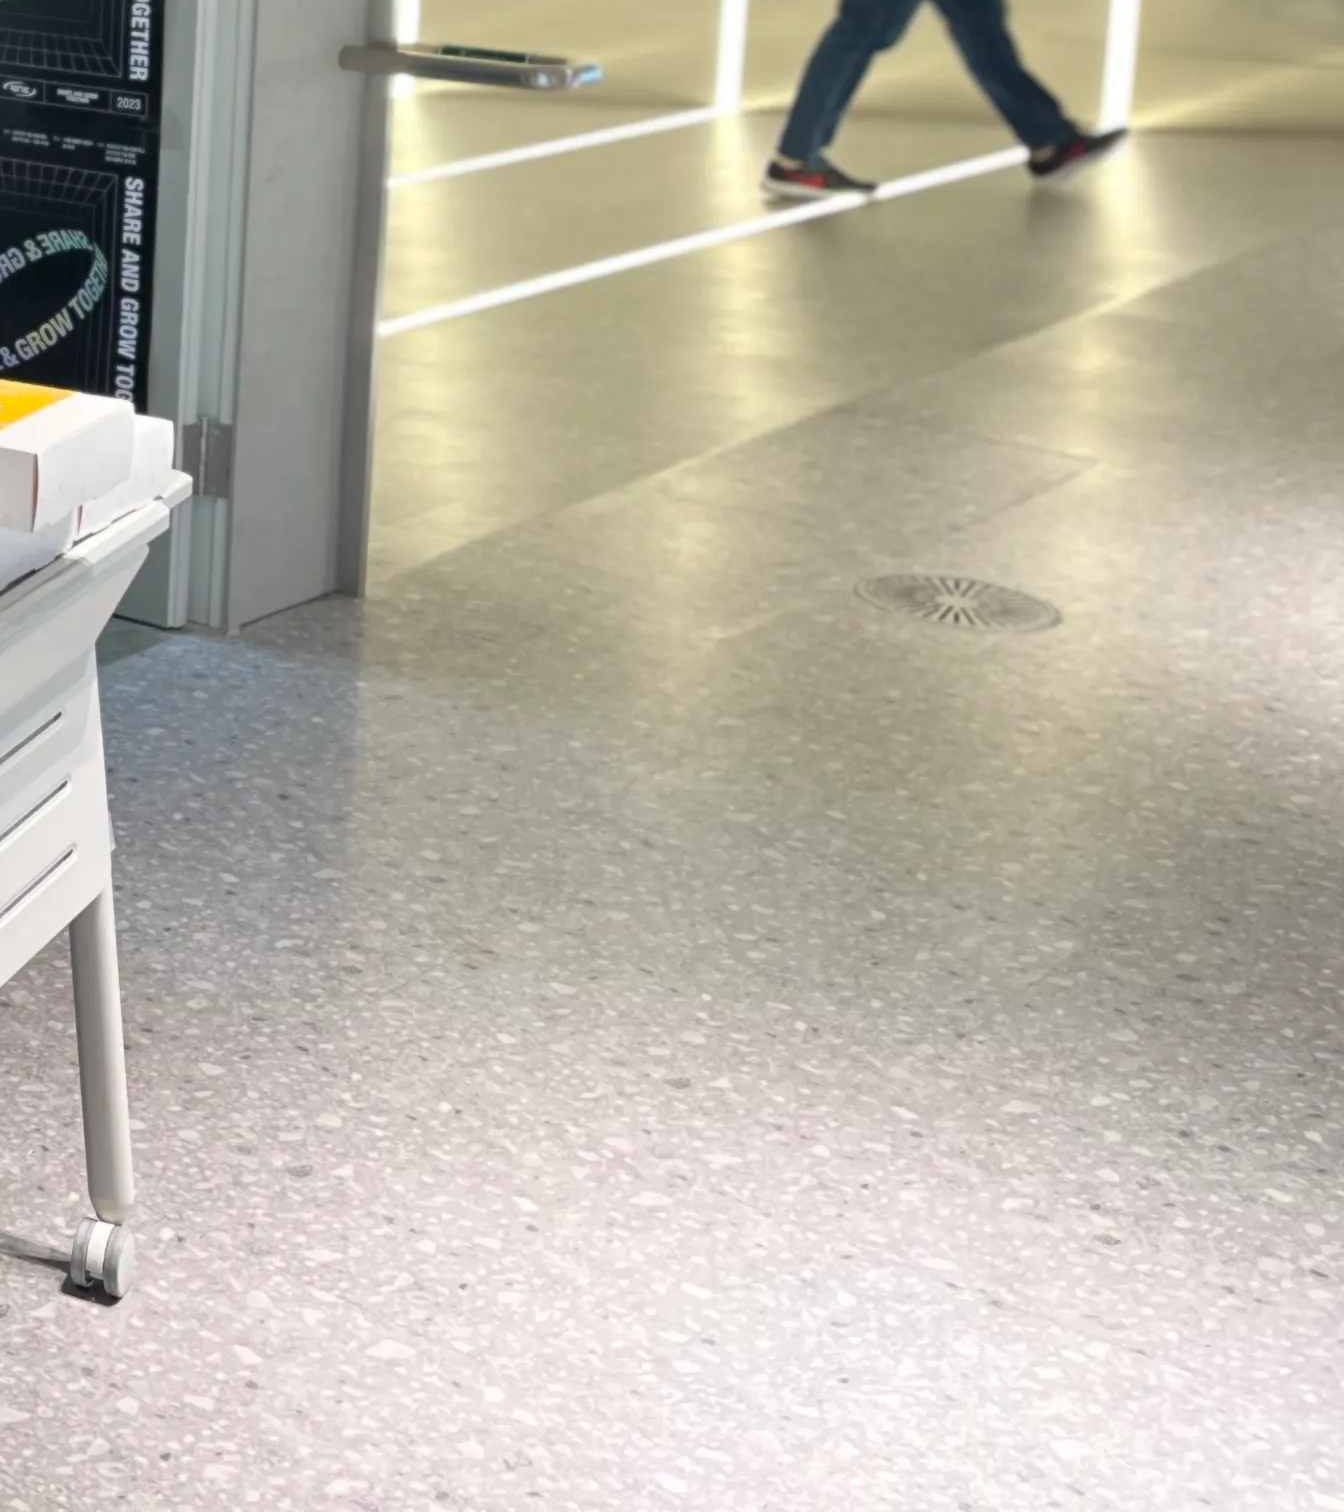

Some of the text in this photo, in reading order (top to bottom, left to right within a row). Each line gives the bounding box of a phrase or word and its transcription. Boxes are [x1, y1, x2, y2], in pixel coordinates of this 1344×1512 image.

[117, 96, 140, 110] 2023
[119, 177, 142, 359] SHARE AND GROW
